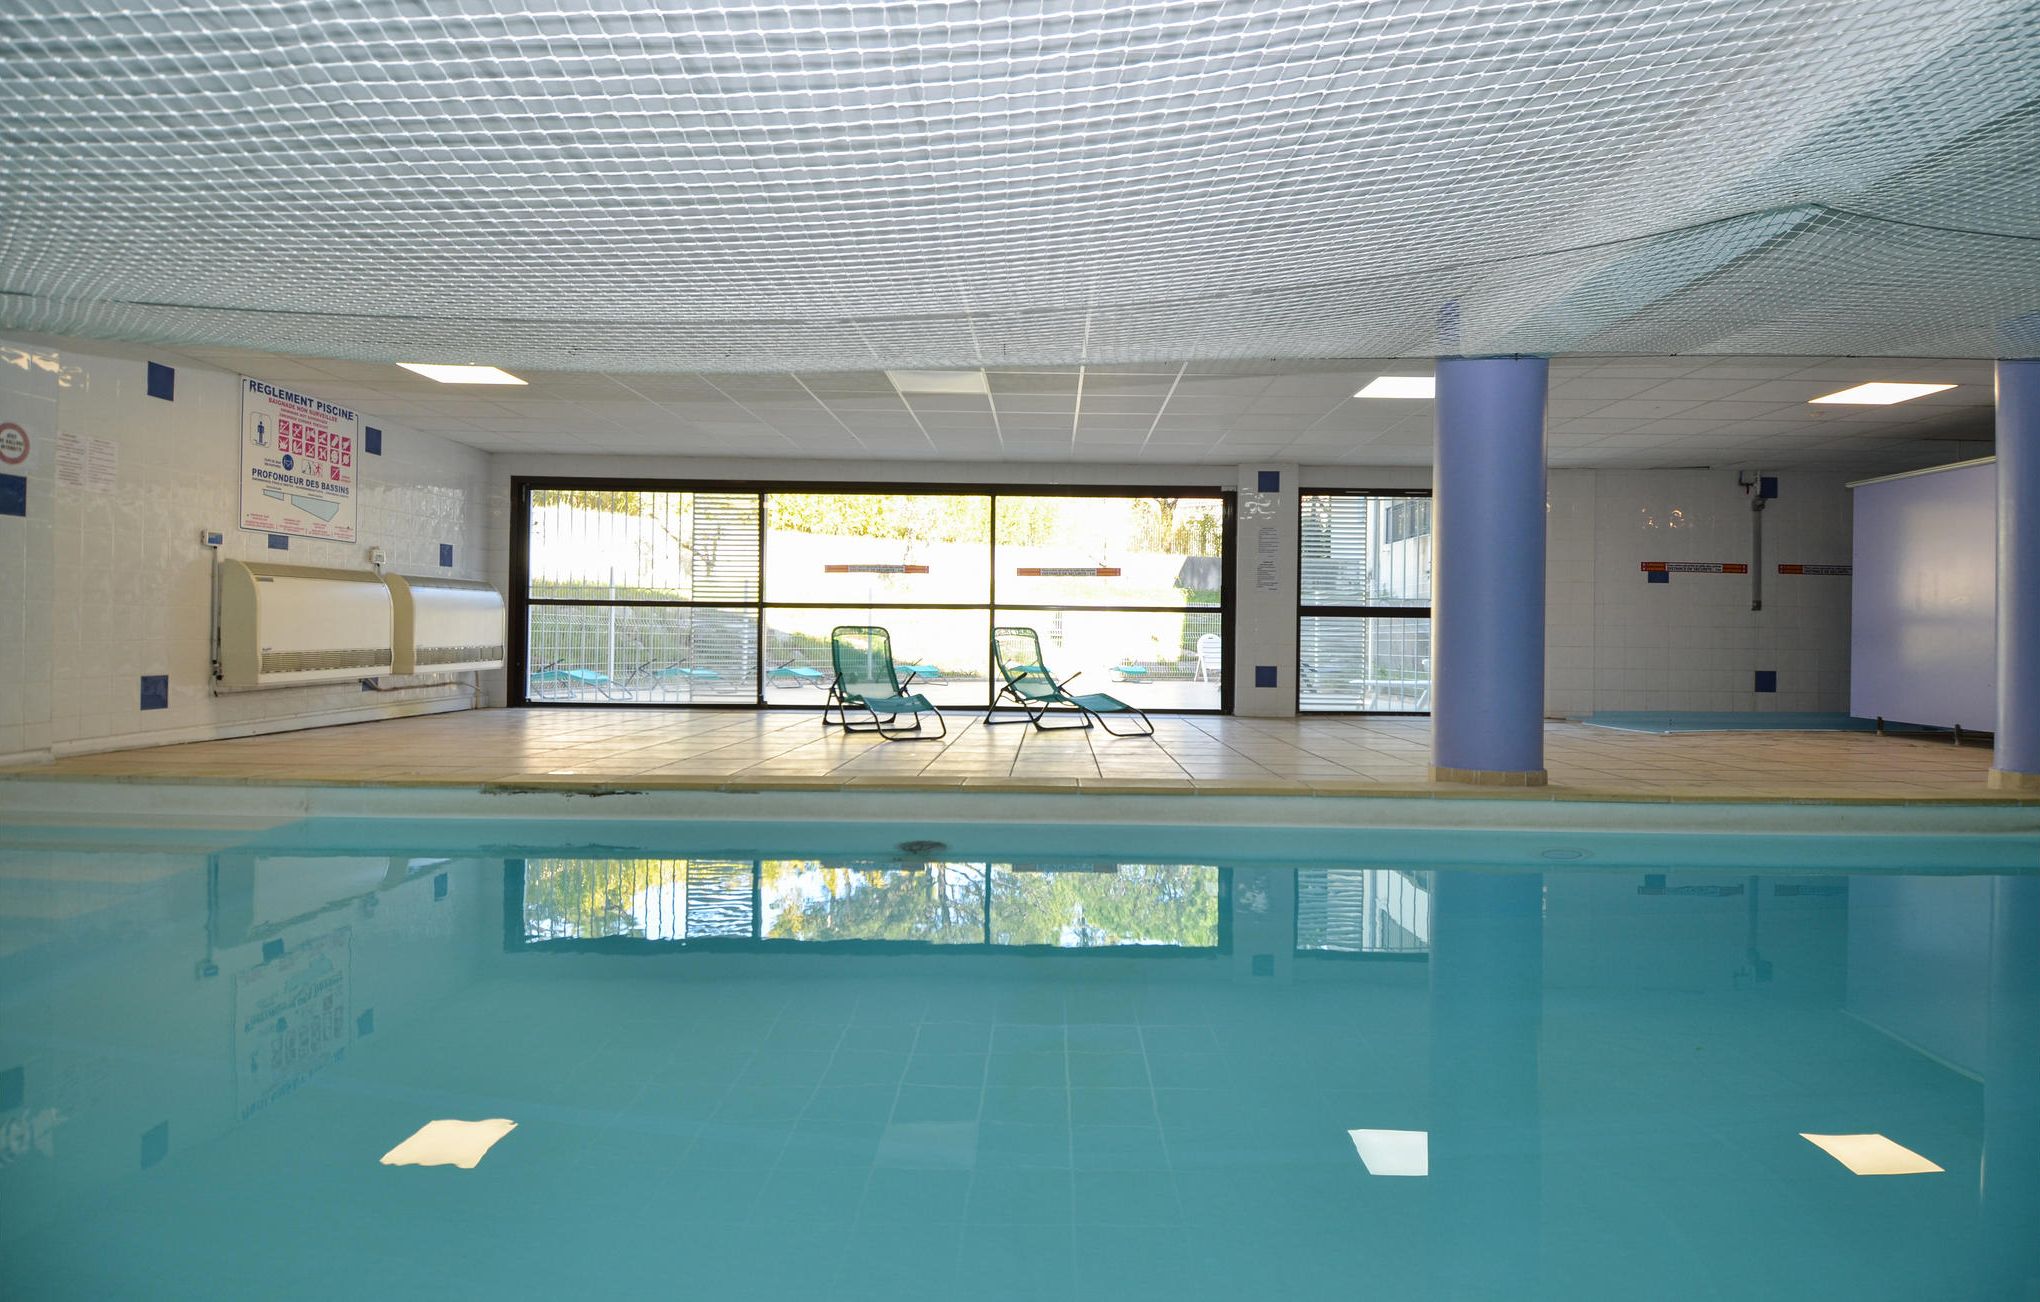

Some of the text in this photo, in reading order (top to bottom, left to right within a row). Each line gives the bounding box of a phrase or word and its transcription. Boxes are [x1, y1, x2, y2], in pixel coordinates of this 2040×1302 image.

[249, 380, 314, 408] REGLEMENT
[317, 401, 354, 421] PISCINE
[268, 398, 295, 410] BAIGNADE
[296, 405, 308, 413] NON
[251, 468, 304, 486] PROFONDEUR
[305, 479, 320, 489] DES
[321, 482, 350, 495] BASSINS
